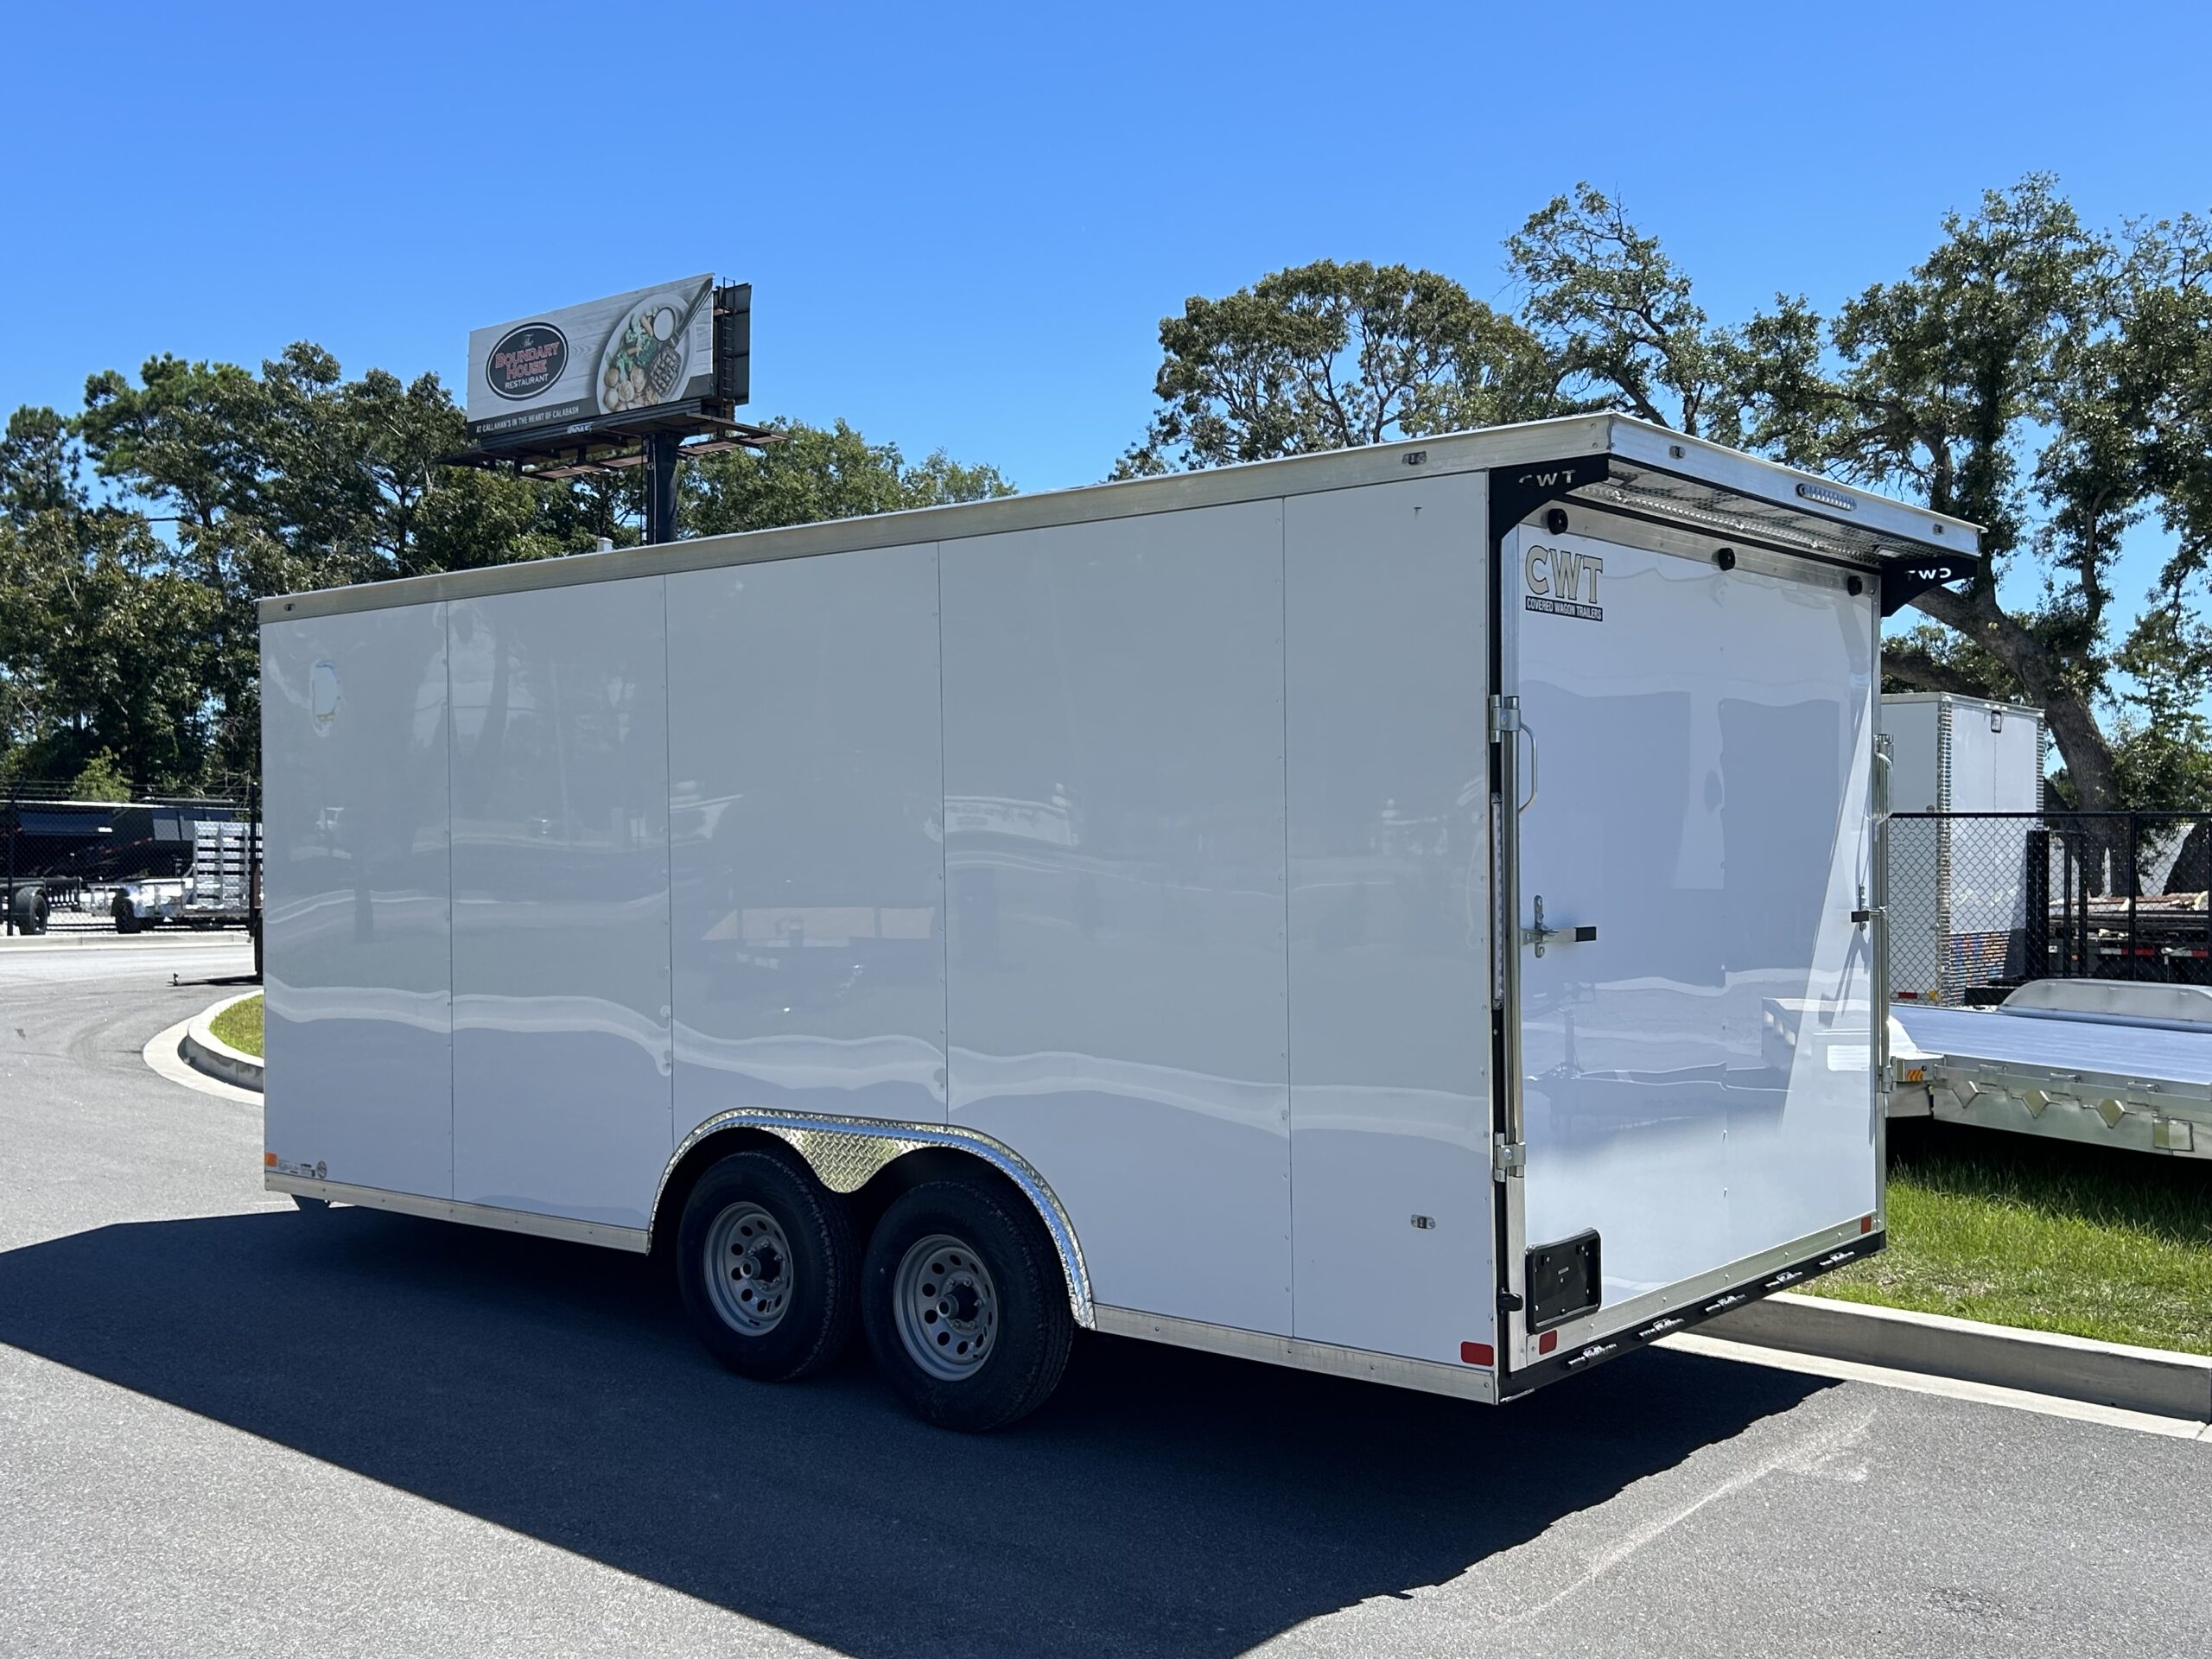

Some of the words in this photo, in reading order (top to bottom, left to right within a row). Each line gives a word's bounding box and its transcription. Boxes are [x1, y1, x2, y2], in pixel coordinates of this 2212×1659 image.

[495, 341, 560, 369] BOUNDARY
[506, 359, 548, 380] HOUSE
[505, 373, 549, 390] RESTAURANT
[476, 425, 483, 434] AT
[518, 416, 528, 425] THE
[528, 412, 545, 423] HEART
[544, 410, 552, 420] OF
[552, 406, 579, 418] CALABASH
[1519, 469, 1576, 487] CWT
[1525, 544, 1604, 604] CWT
[1527, 597, 1554, 613] COVERED
[1554, 601, 1576, 616] WAGON
[1576, 605, 1602, 620] TRAILERS
